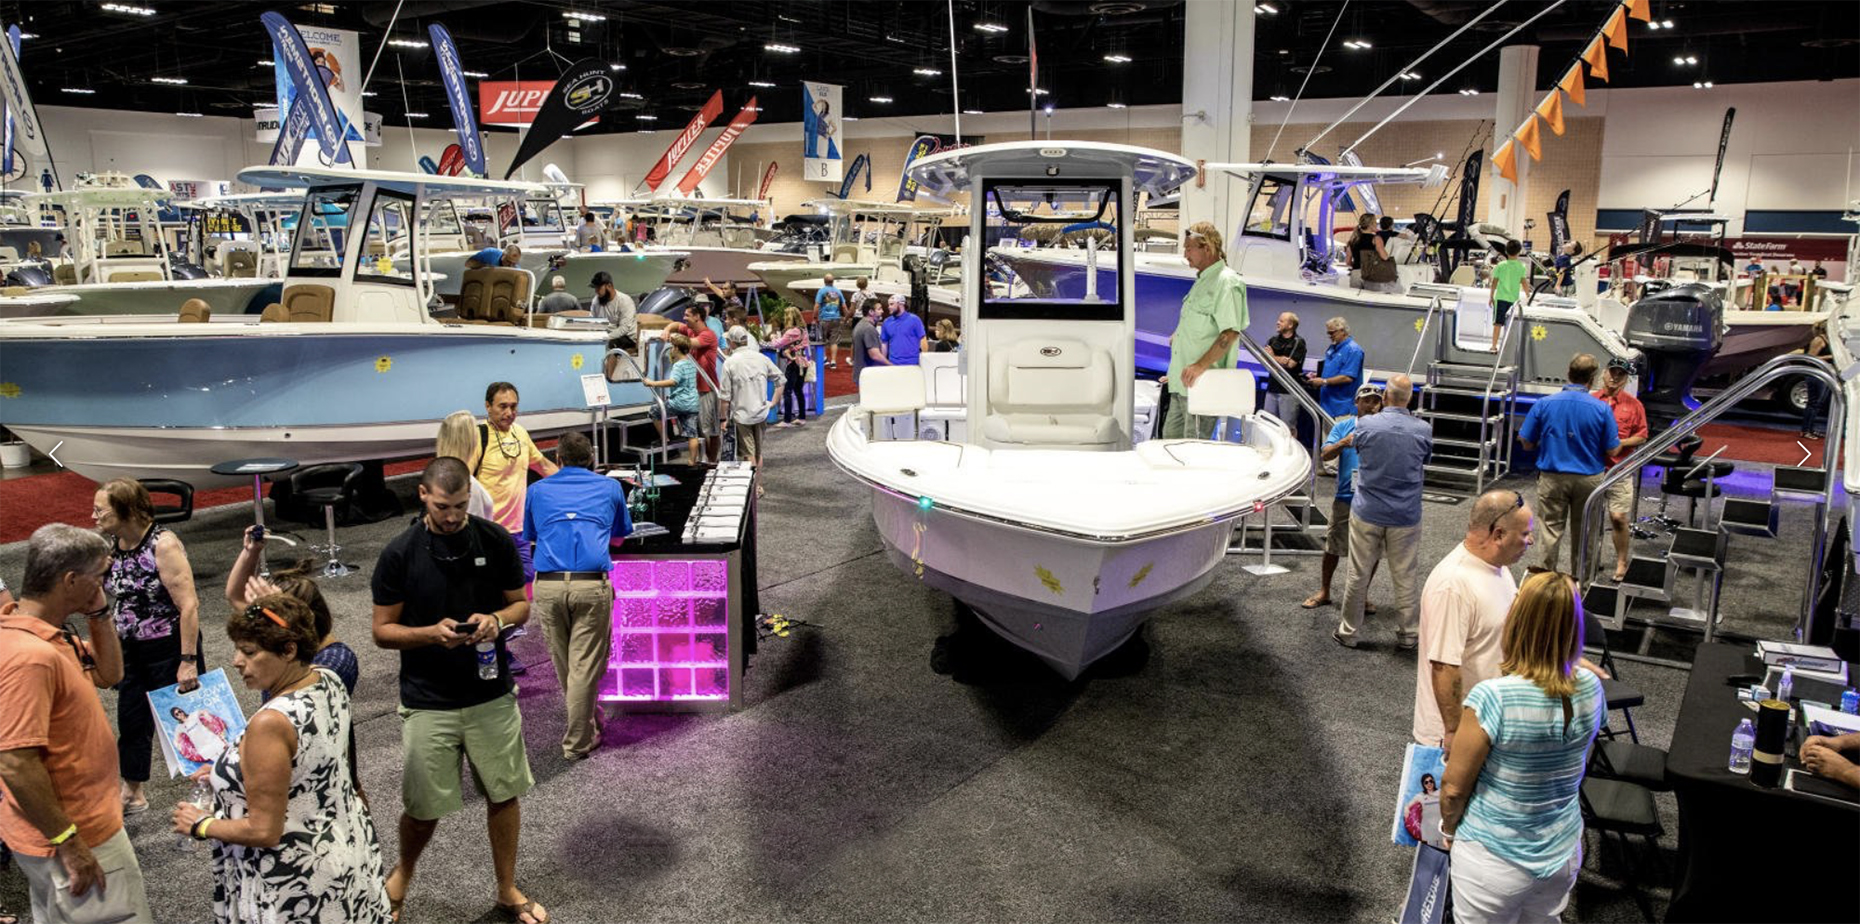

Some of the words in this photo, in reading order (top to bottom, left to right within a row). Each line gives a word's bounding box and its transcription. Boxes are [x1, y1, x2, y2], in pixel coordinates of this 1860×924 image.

[300, 30, 342, 43] ELCOME,
[562, 78, 578, 93] SEA
[579, 70, 605, 79] HUNT
[486, 89, 553, 115] JUPI
[581, 98, 609, 115] BOATS
[667, 113, 705, 173] JUPITER
[821, 162, 829, 177] B
[1673, 323, 1703, 333] YAMAHA
